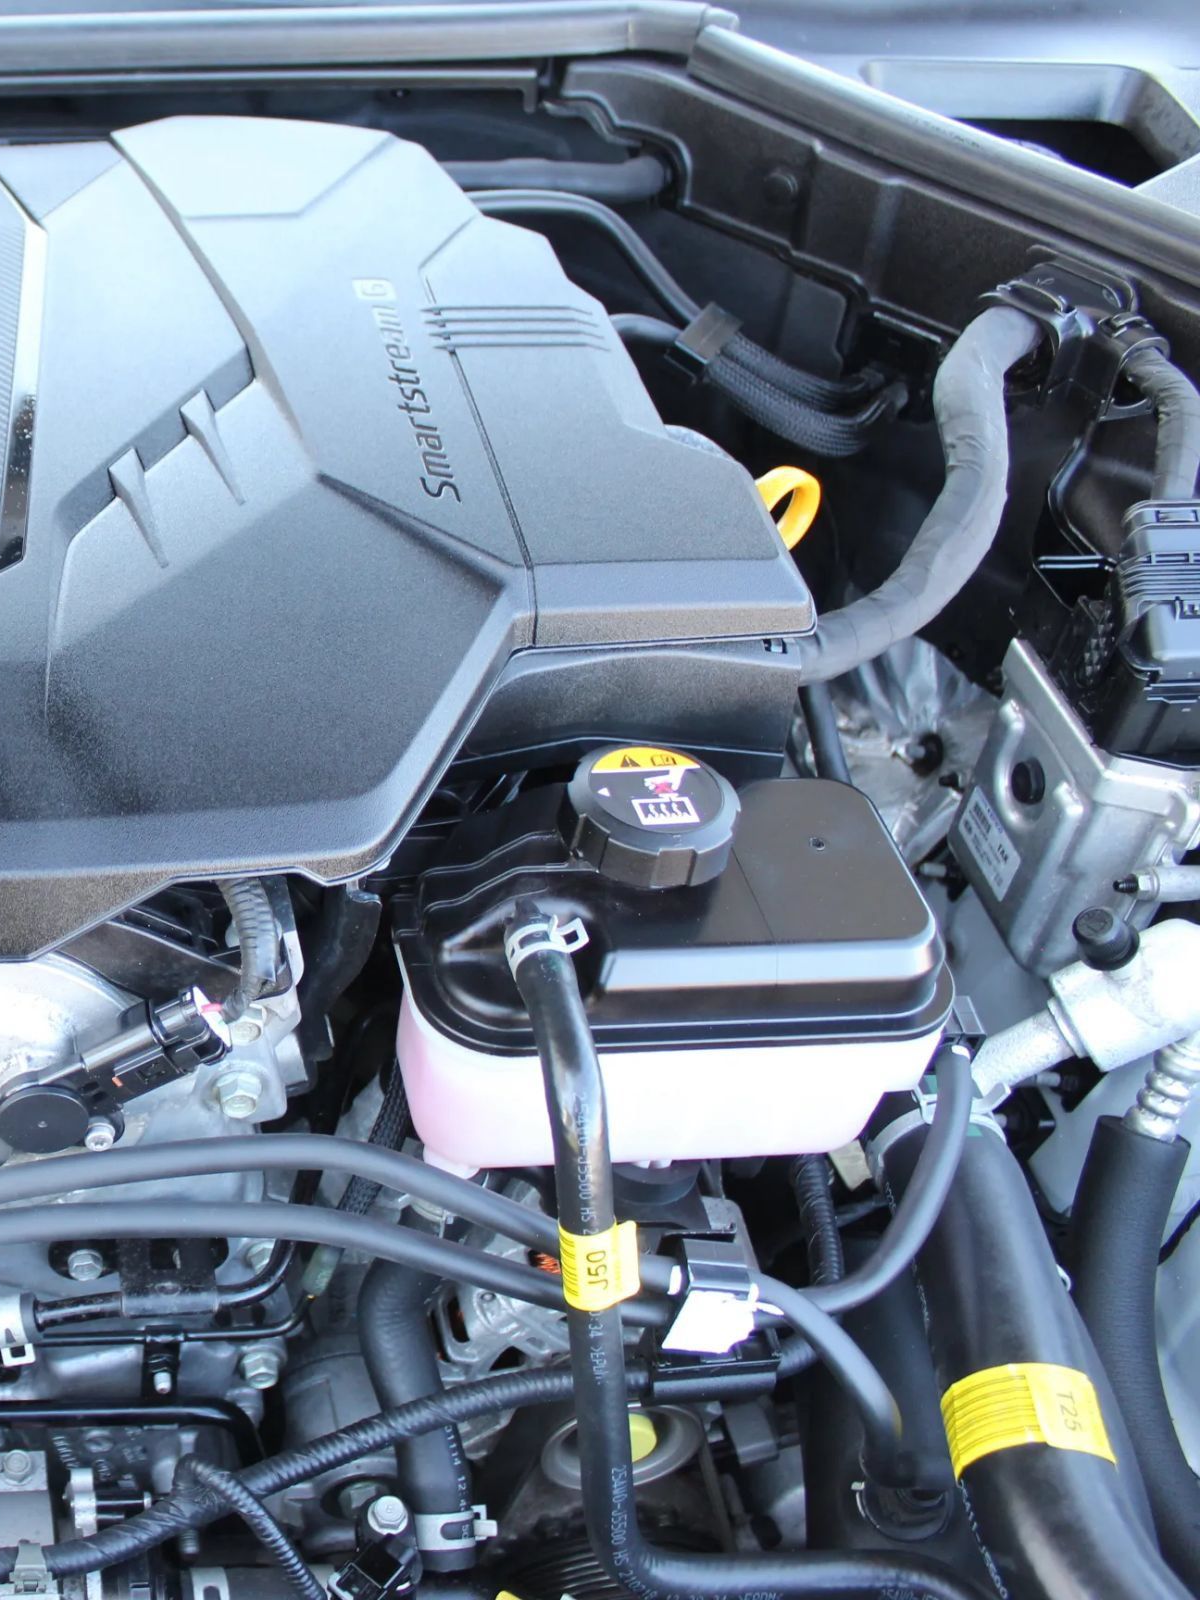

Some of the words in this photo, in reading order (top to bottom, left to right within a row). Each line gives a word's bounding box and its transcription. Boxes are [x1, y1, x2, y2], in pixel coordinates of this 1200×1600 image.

[372, 304, 462, 503] Smartstream
[586, 1250, 609, 1291] J50
[1056, 1391, 1083, 1433] T25
